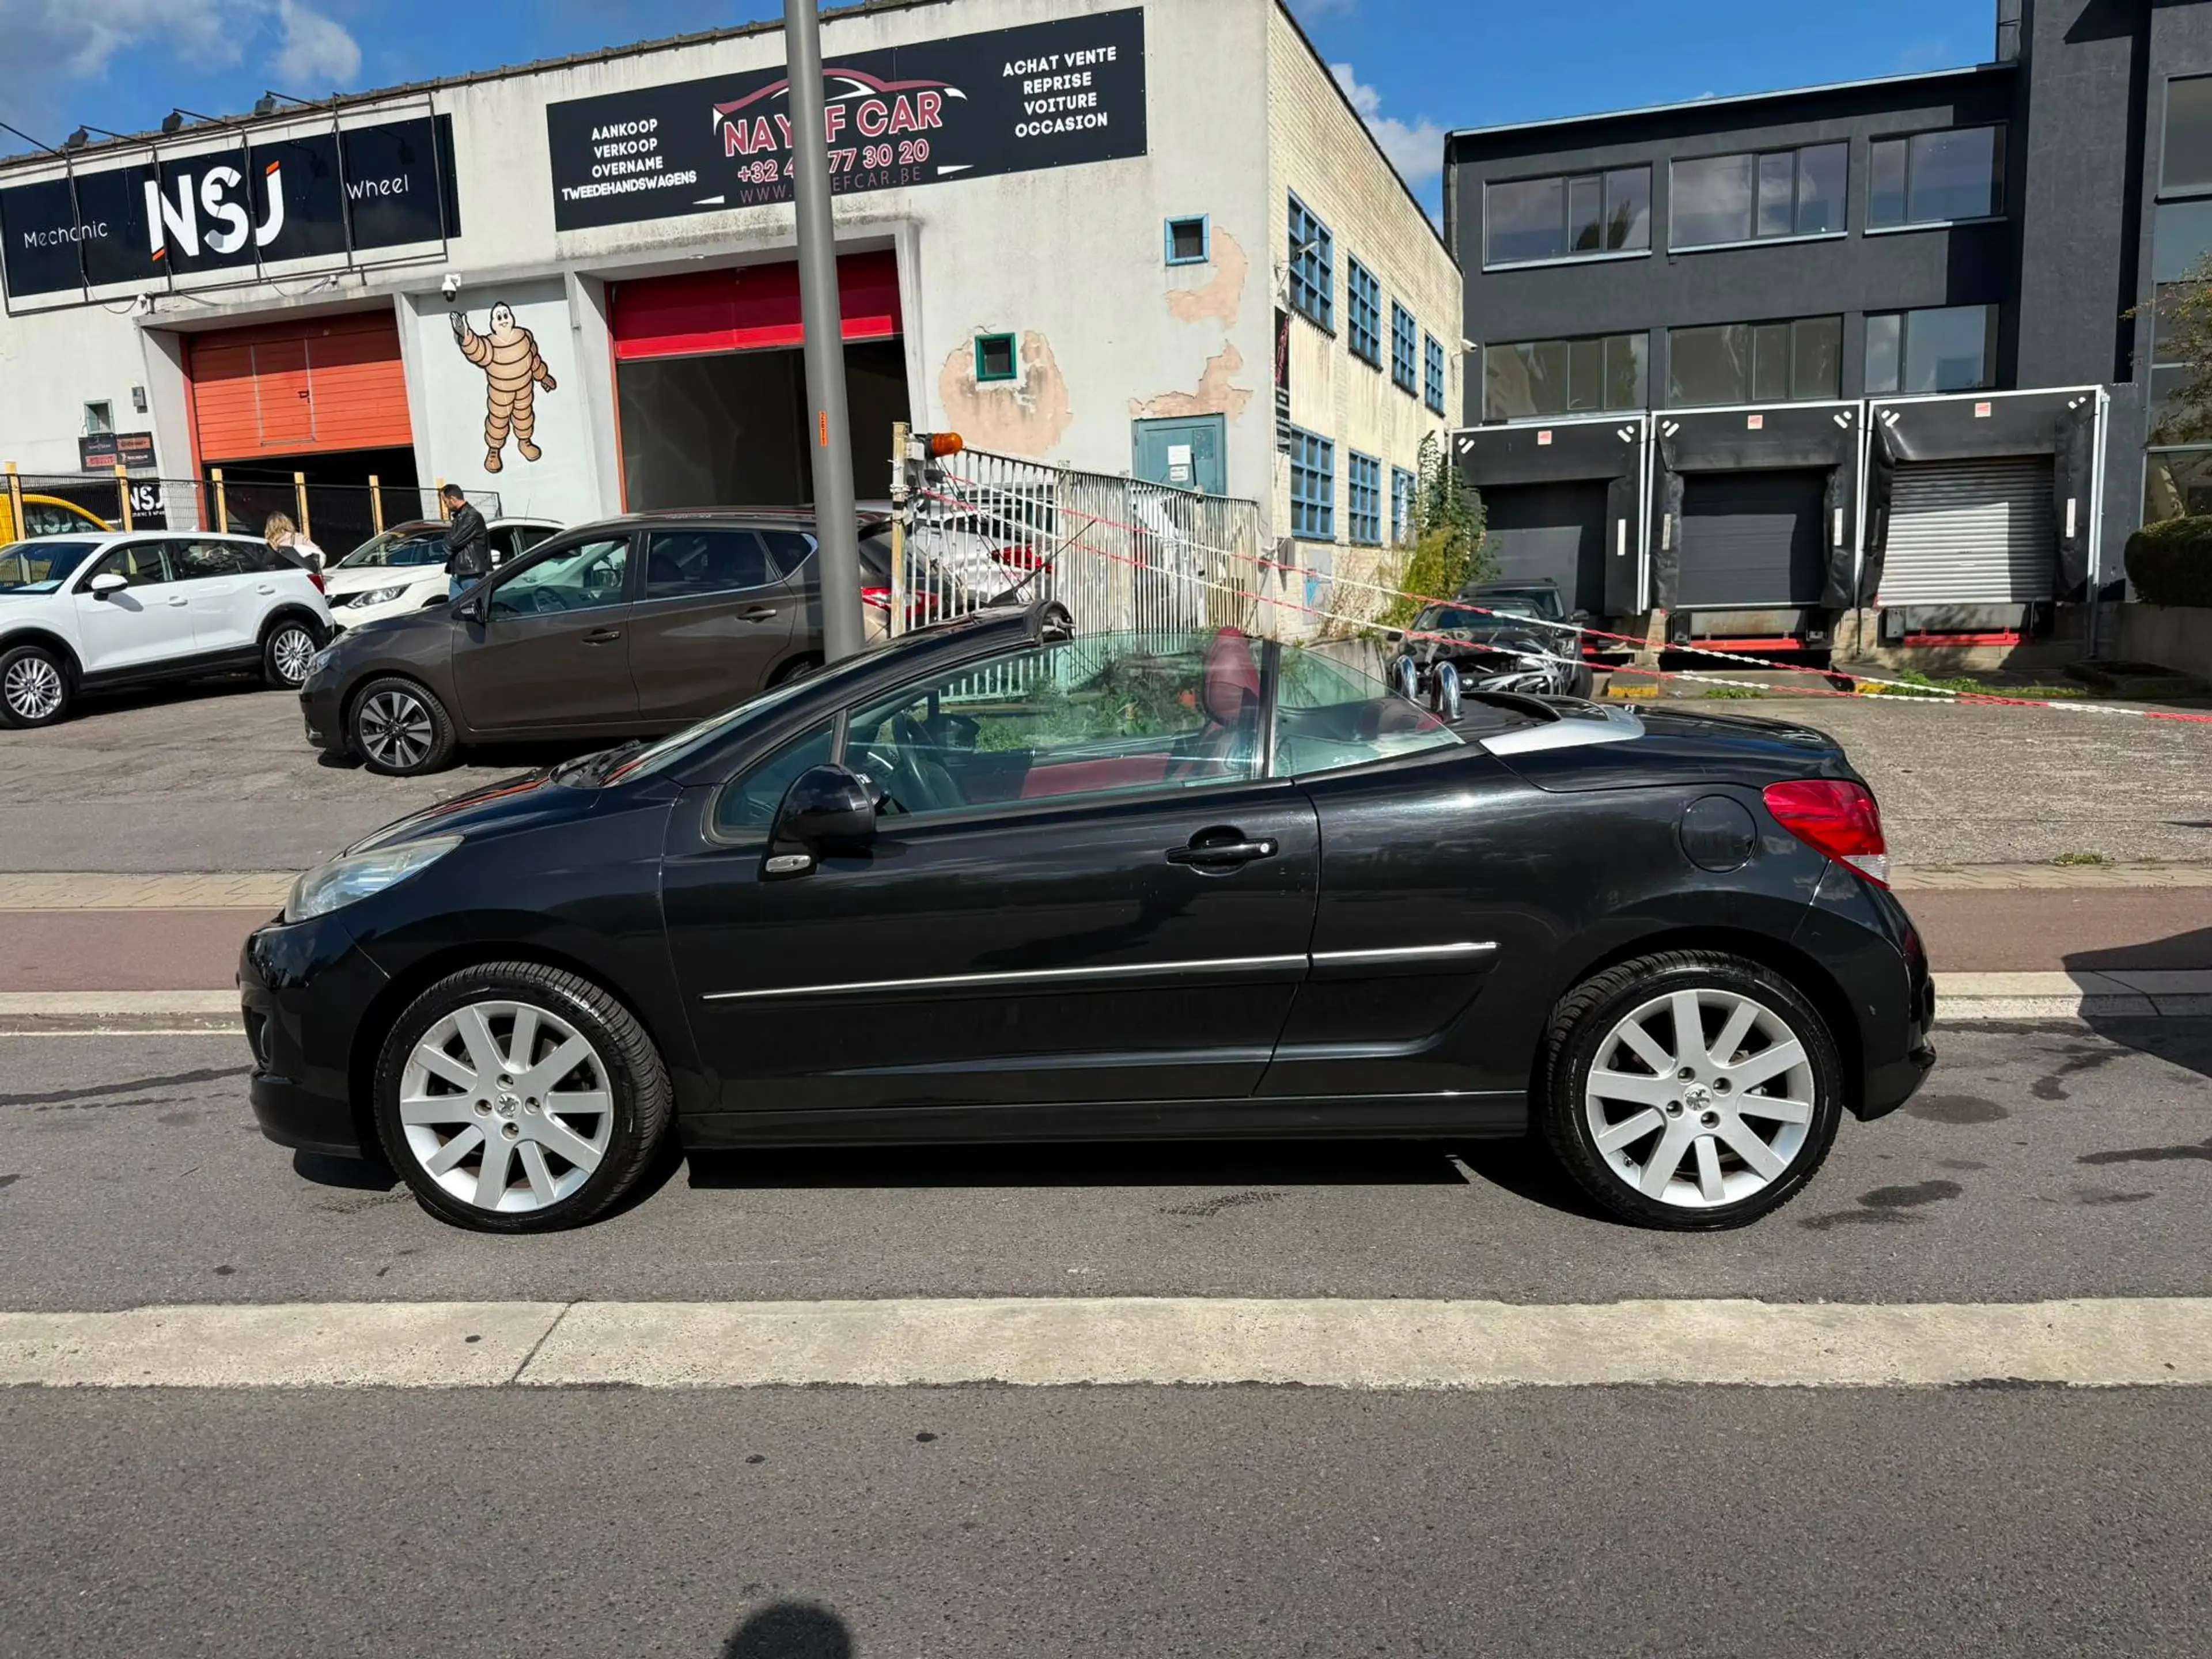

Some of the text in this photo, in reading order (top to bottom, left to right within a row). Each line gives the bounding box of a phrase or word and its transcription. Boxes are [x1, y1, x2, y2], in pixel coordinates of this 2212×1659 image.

[1002, 46, 1116, 77] ACHAT VENTE
[1023, 71, 1092, 94] REPRISE
[1024, 92, 1097, 115] VOITURE
[592, 119, 658, 141] AANKOOP
[724, 90, 942, 157] NAYF CAR
[1015, 112, 1107, 138] OCCASION
[594, 138, 658, 158] VERKOOP
[738, 160, 778, 183] +32
[827, 149, 857, 173] 77
[863, 145, 892, 169] 30
[899, 139, 929, 165] 20
[592, 156, 663, 178] OVERNAME
[346, 174, 408, 199] Wheel
[562, 170, 697, 200] TWEEDEHANDSWAGENS
[144, 160, 284, 261] NSJ
[24, 220, 108, 248] Mechanic
